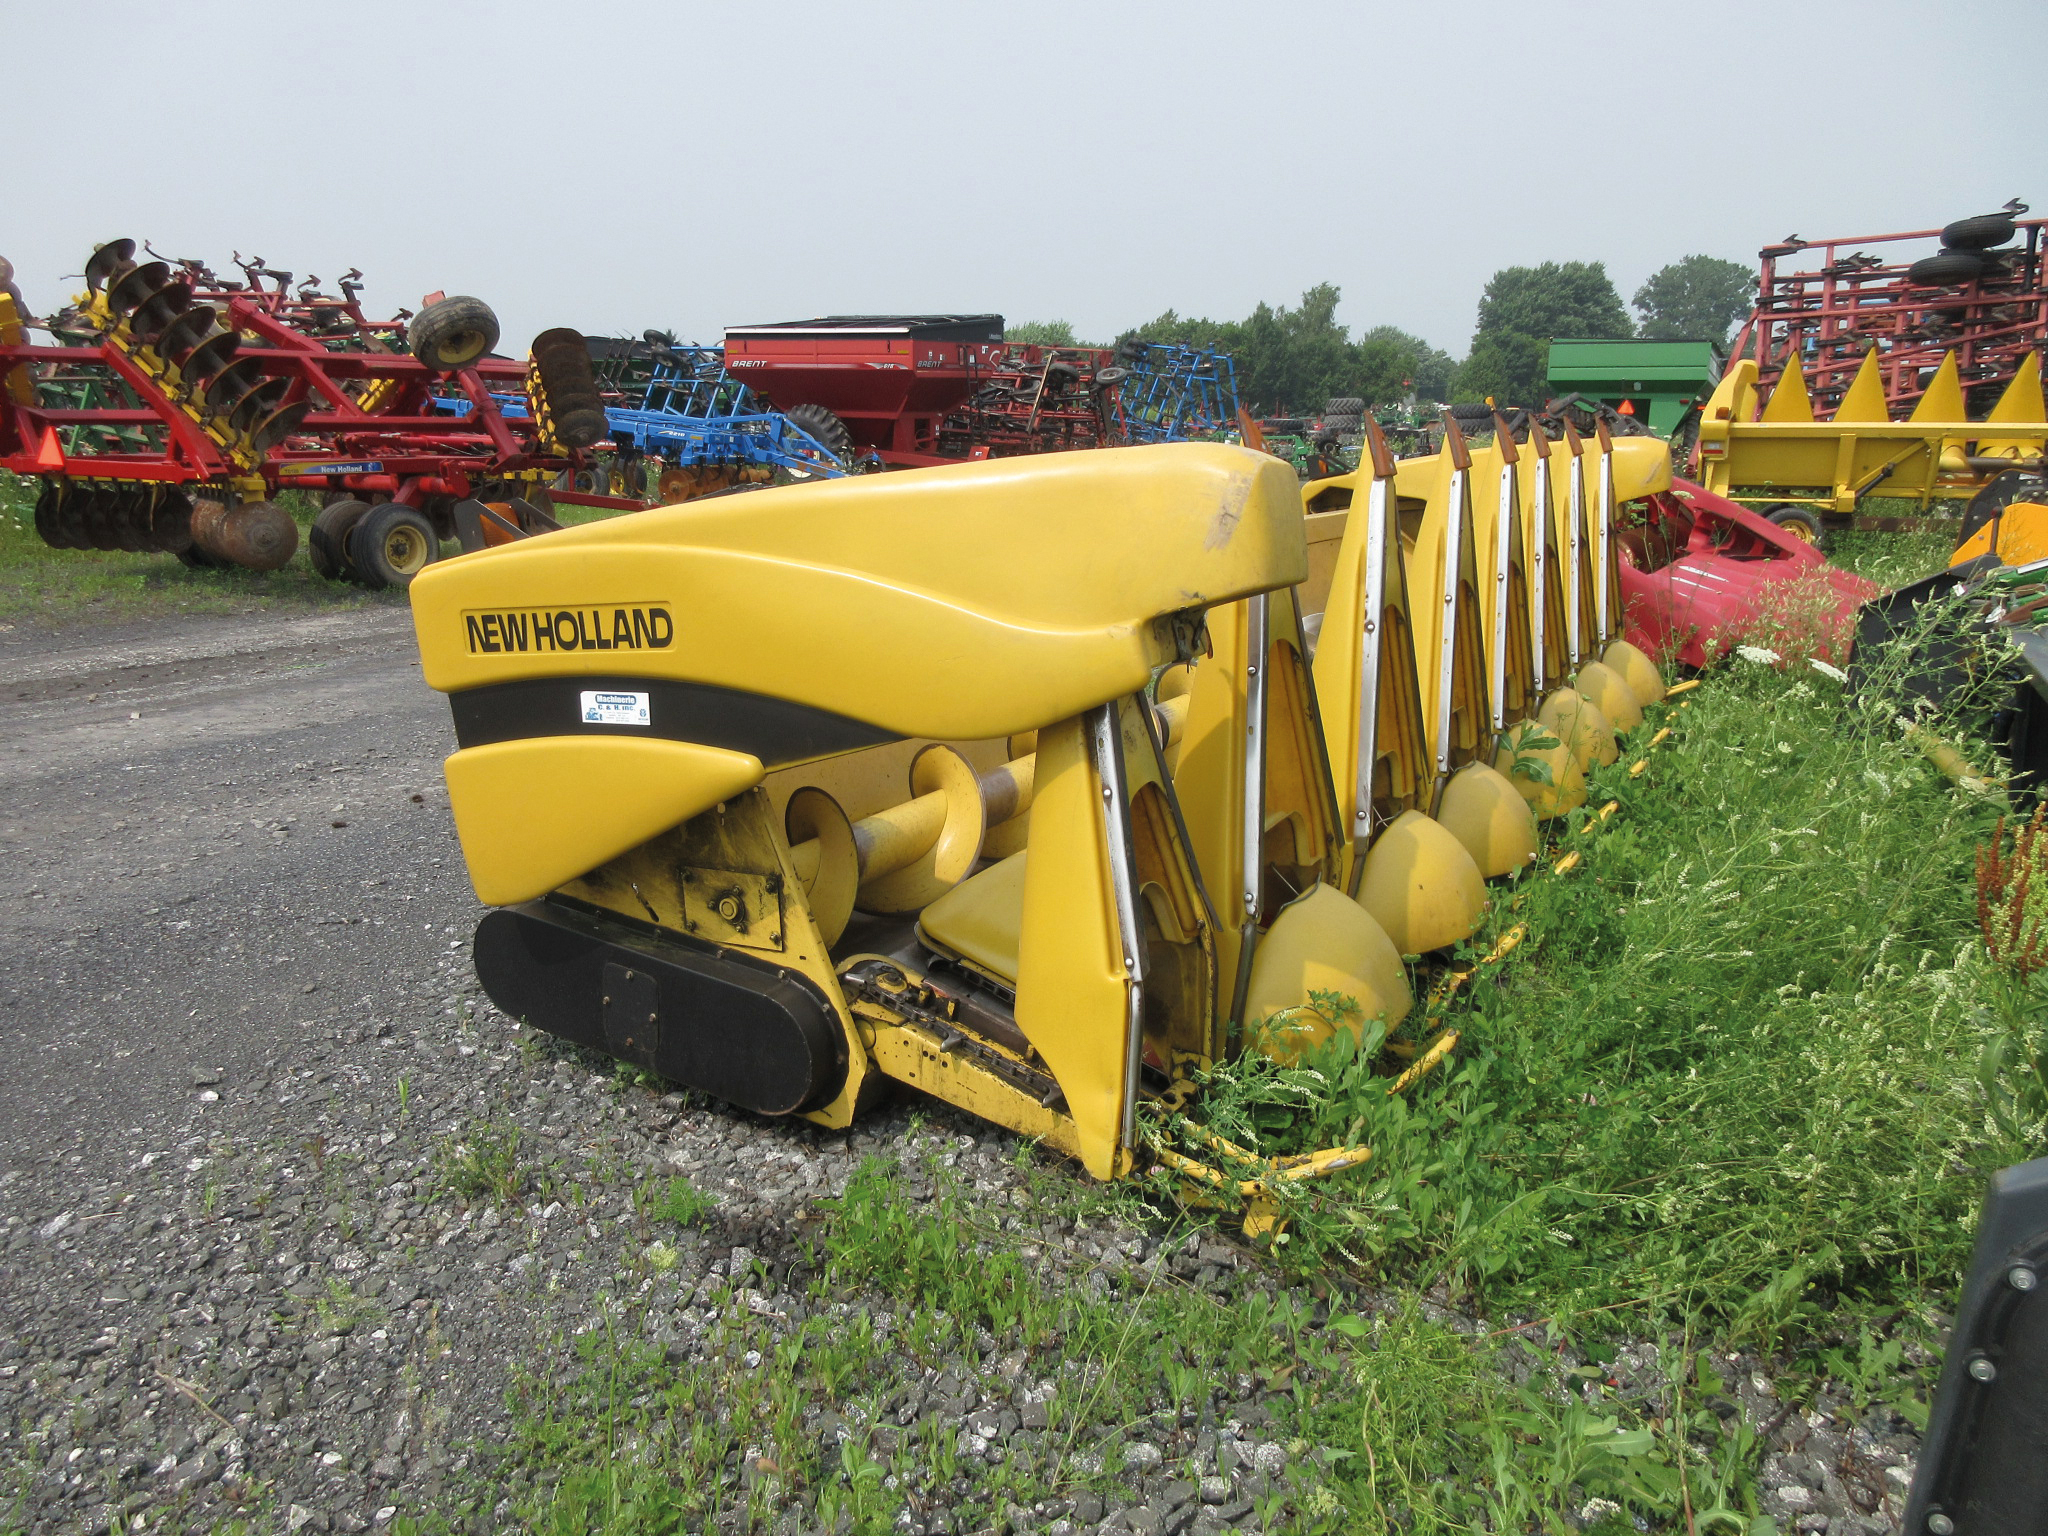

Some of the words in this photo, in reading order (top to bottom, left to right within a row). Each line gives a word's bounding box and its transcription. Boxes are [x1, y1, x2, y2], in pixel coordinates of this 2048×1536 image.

[731, 360, 768, 368] BRENT
[917, 360, 942, 368] BRENT
[337, 465, 362, 473] Holland
[466, 613, 528, 653] NEW
[532, 608, 674, 651] HOLLAND
[596, 694, 636, 704] Machinerie
